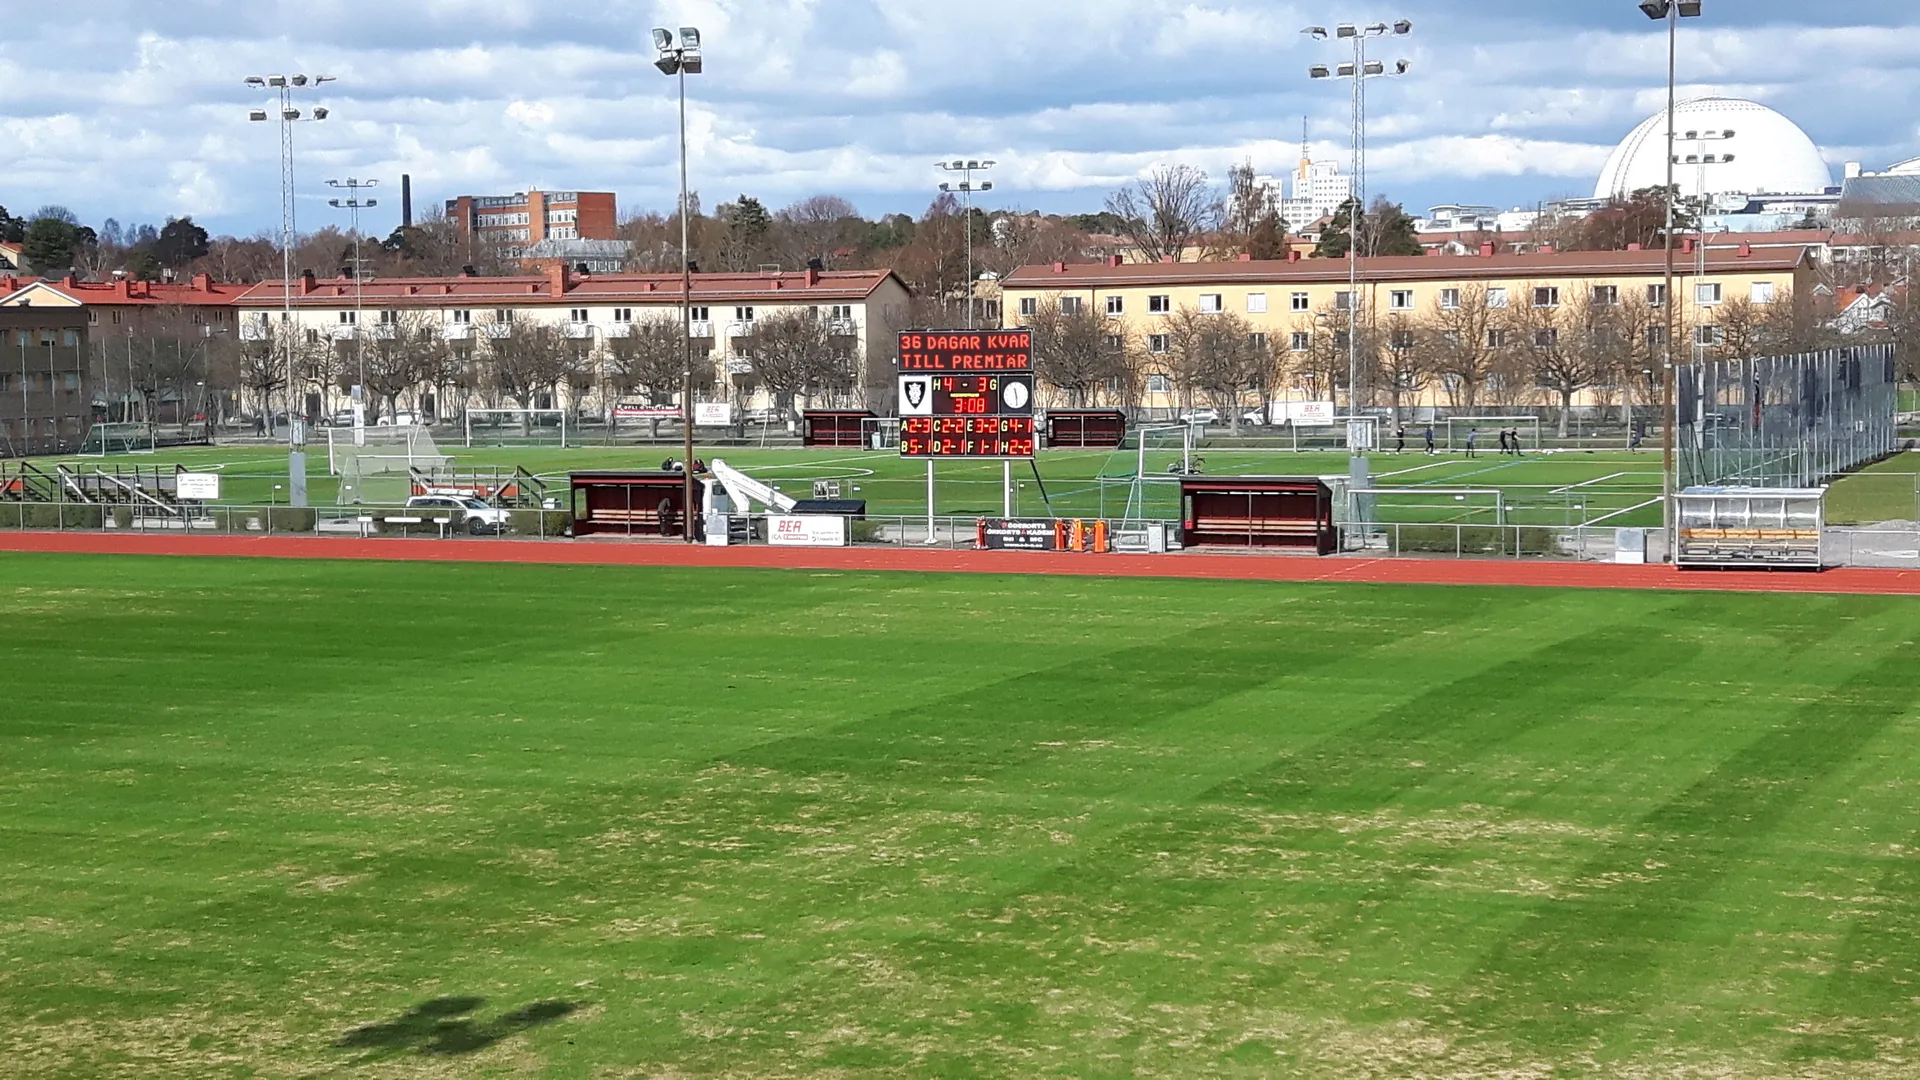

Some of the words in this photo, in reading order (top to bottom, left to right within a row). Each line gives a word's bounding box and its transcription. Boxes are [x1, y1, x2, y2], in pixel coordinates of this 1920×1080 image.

[901, 335, 922, 349] 36
[927, 335, 981, 350] DAGAR
[988, 335, 1029, 348] KVAR
[903, 354, 945, 368] TILL
[952, 354, 1027, 368] PREMIÄR
[933, 379, 941, 391] H
[944, 377, 952, 391] 4
[978, 377, 986, 392] 3
[989, 379, 997, 391] G
[954, 398, 985, 413] 3:08
[901, 420, 908, 432] A
[934, 420, 941, 432] C
[967, 420, 973, 432] E
[1001, 420, 1008, 432] G
[901, 441, 908, 452] B
[934, 441, 941, 453] D
[967, 441, 974, 453] F
[1001, 441, 1009, 453] H
[778, 520, 802, 533] BEA
